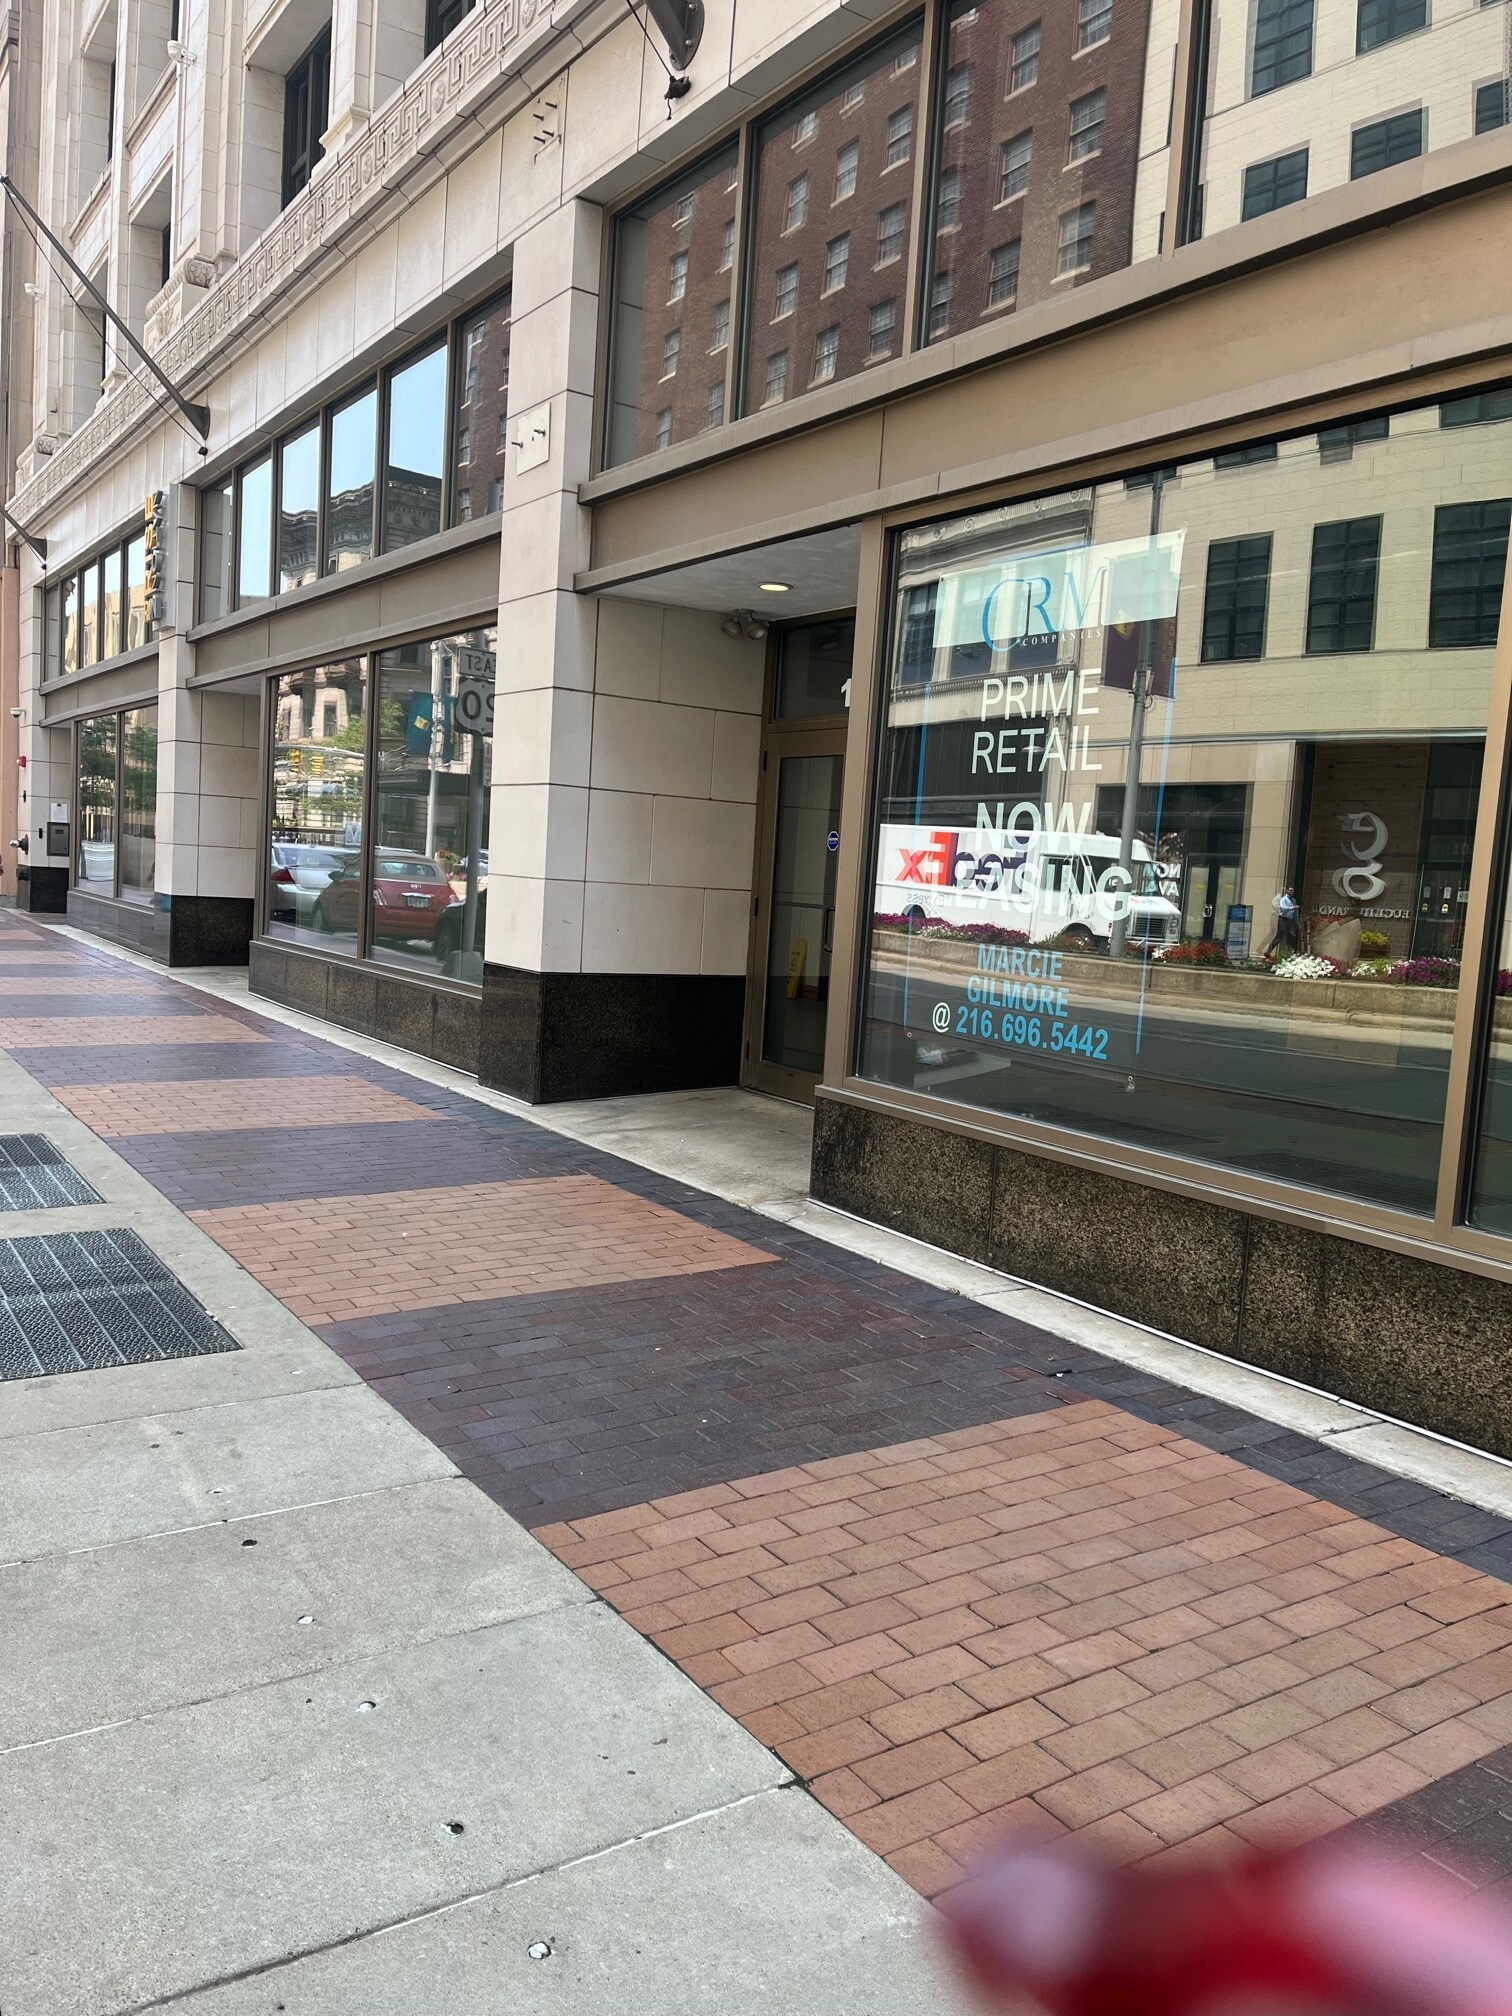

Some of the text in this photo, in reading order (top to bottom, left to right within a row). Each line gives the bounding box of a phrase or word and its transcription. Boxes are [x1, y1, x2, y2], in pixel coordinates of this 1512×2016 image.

[982, 566, 1109, 652] CRM
[1022, 629, 1101, 646] COMPANIES
[981, 667, 1101, 722] PRIME
[971, 725, 1102, 774] RETAIL
[975, 801, 1092, 854] NOW
[930, 857, 1133, 921] LEASING
[977, 943, 1064, 981] MARCIE
[967, 975, 1070, 1017] GILMORE
[932, 1002, 1109, 1060] @ 216.696.5442
